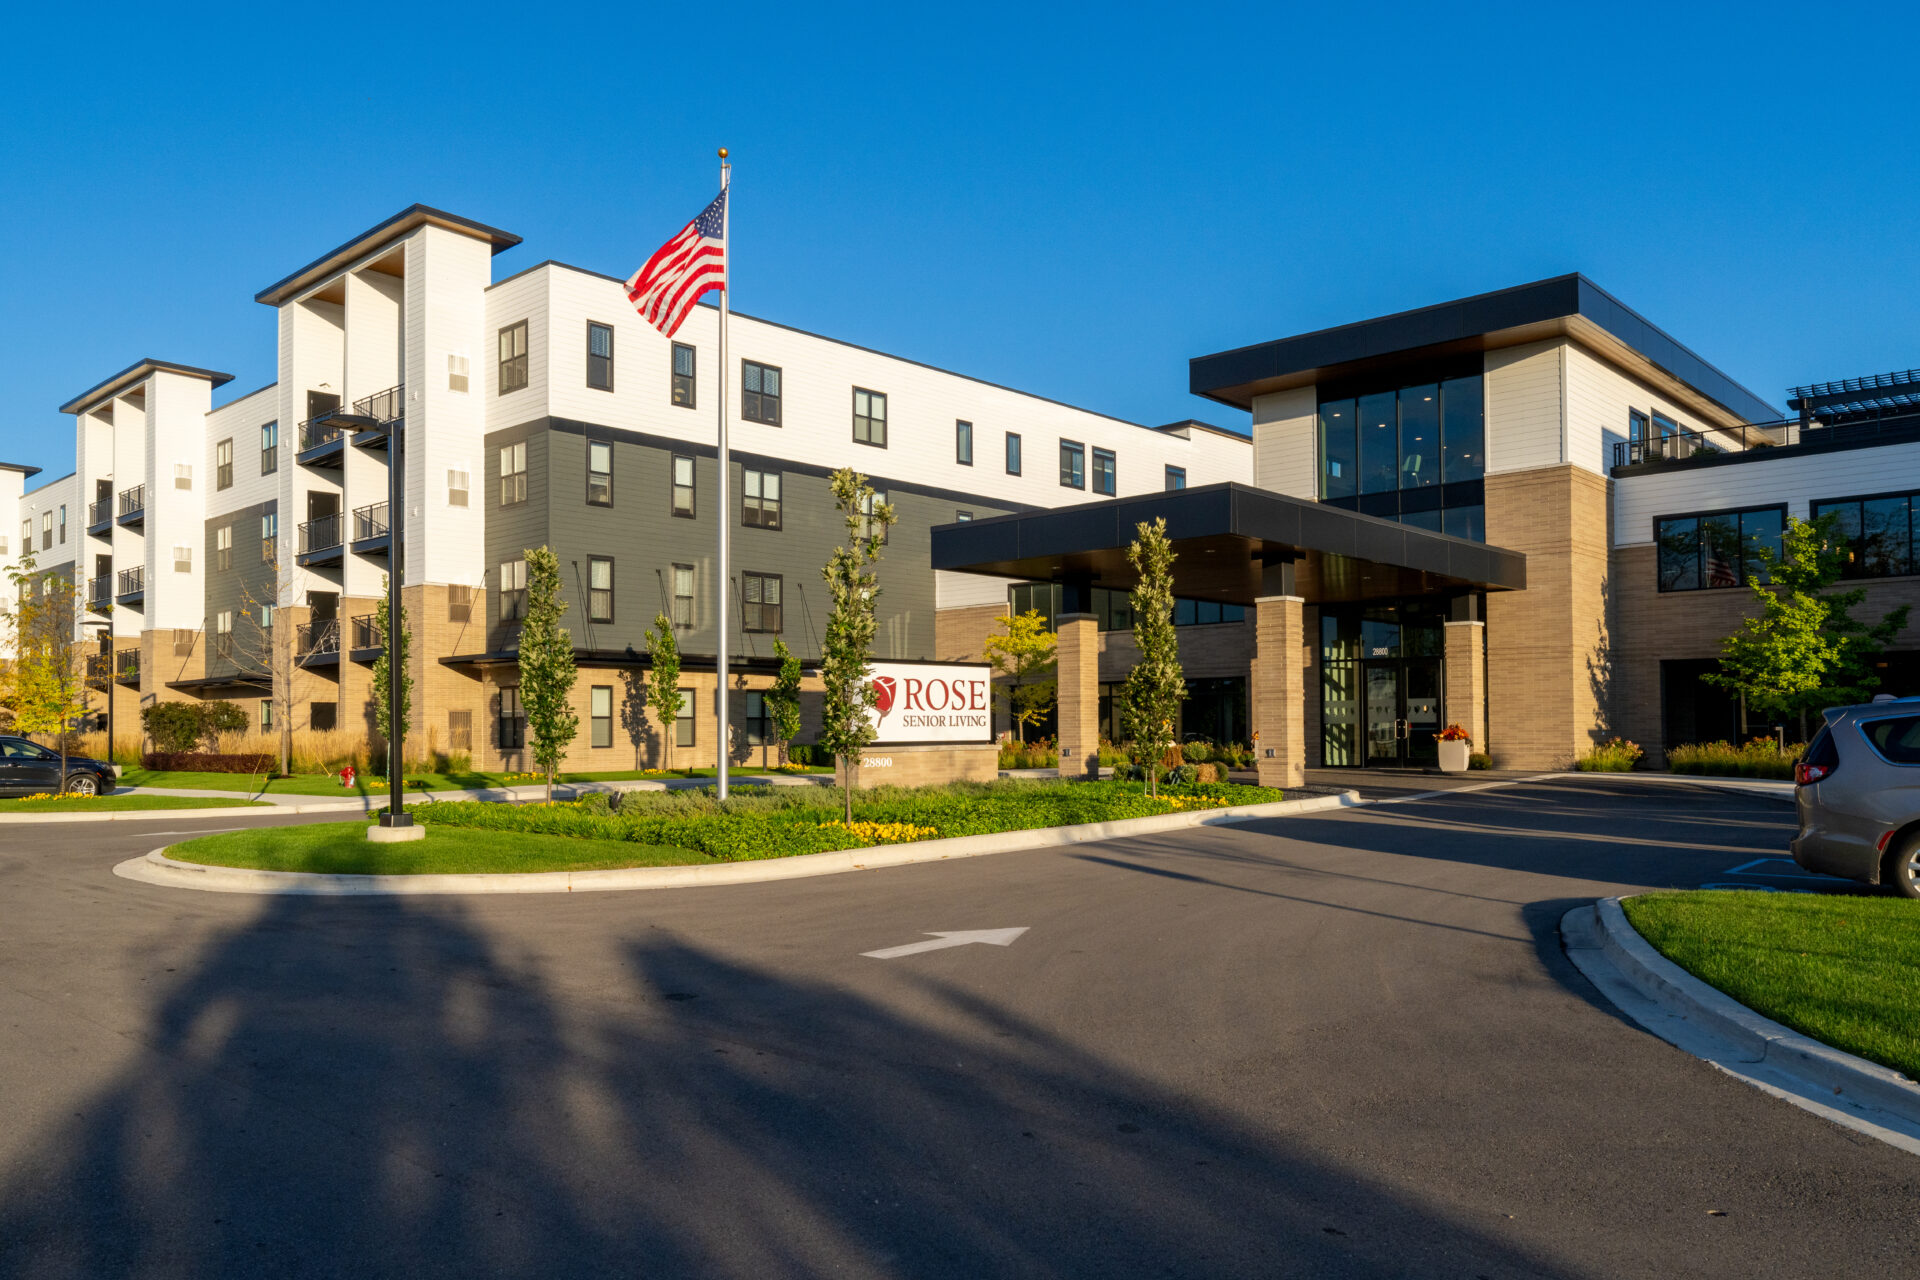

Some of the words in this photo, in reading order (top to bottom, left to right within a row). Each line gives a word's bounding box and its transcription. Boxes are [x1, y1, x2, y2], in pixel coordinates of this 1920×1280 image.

[1372, 647, 1388, 656] 28800
[903, 678, 986, 711] ROSE
[903, 715, 946, 727] SENIOR
[949, 715, 986, 727] LIVING
[863, 757, 893, 768] 28800
